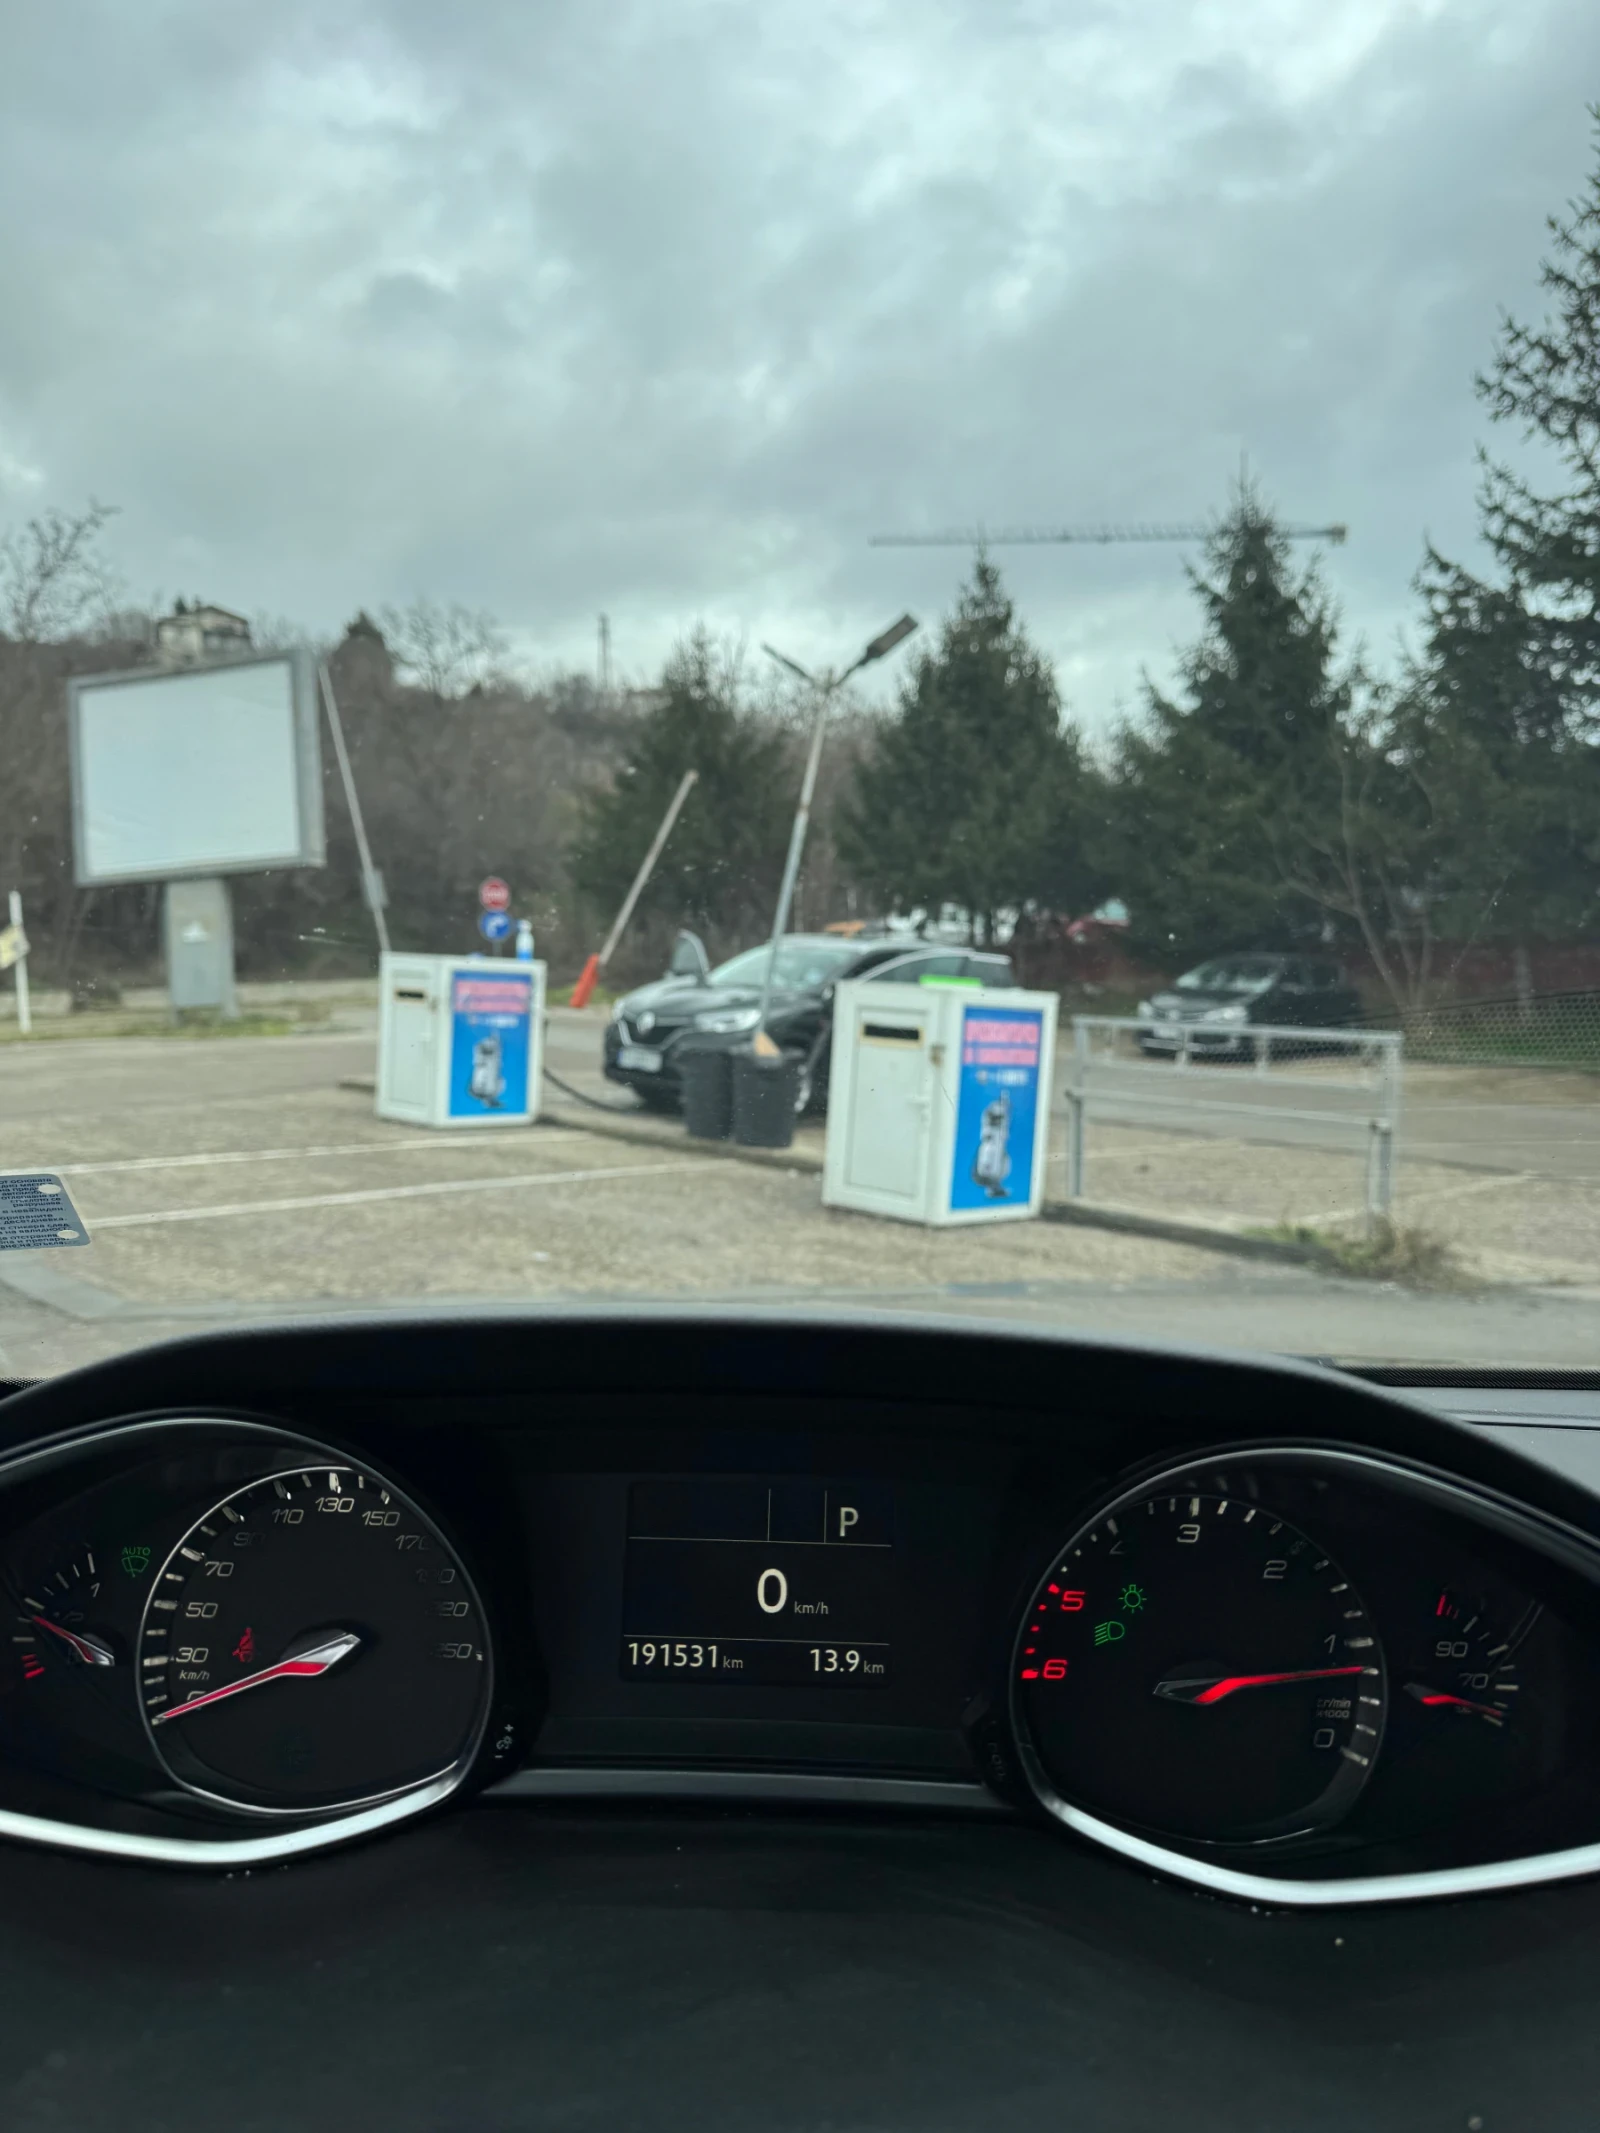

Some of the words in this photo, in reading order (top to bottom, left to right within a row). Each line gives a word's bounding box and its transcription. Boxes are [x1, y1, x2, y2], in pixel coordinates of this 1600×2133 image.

[315, 1497, 354, 1513] 130
[272, 1509, 304, 1524] 110
[362, 1511, 400, 1526] 150
[839, 1507, 859, 1537] P
[1176, 1523, 1201, 1544] 3
[122, 1547, 151, 1556] AUTO
[204, 1561, 234, 1577] 70
[1262, 1559, 1288, 1580] 2
[90, 1582, 100, 1598] 1
[757, 1568, 788, 1613] 0
[794, 1602, 829, 1614] km/h
[1060, 1590, 1086, 1611] 5
[185, 1602, 218, 1618] 50
[1324, 1633, 1337, 1654] 1
[1435, 1640, 1469, 1658] 90
[176, 1648, 209, 1663] 30
[628, 1643, 718, 1668] 191531
[723, 1656, 744, 1668] km
[809, 1649, 860, 1672] 13.9
[864, 1661, 884, 1674] km
[179, 1670, 210, 1680] km/h
[1042, 1659, 1069, 1680] 6
[1456, 1673, 1489, 1690] 70
[1313, 1728, 1335, 1748] 0
